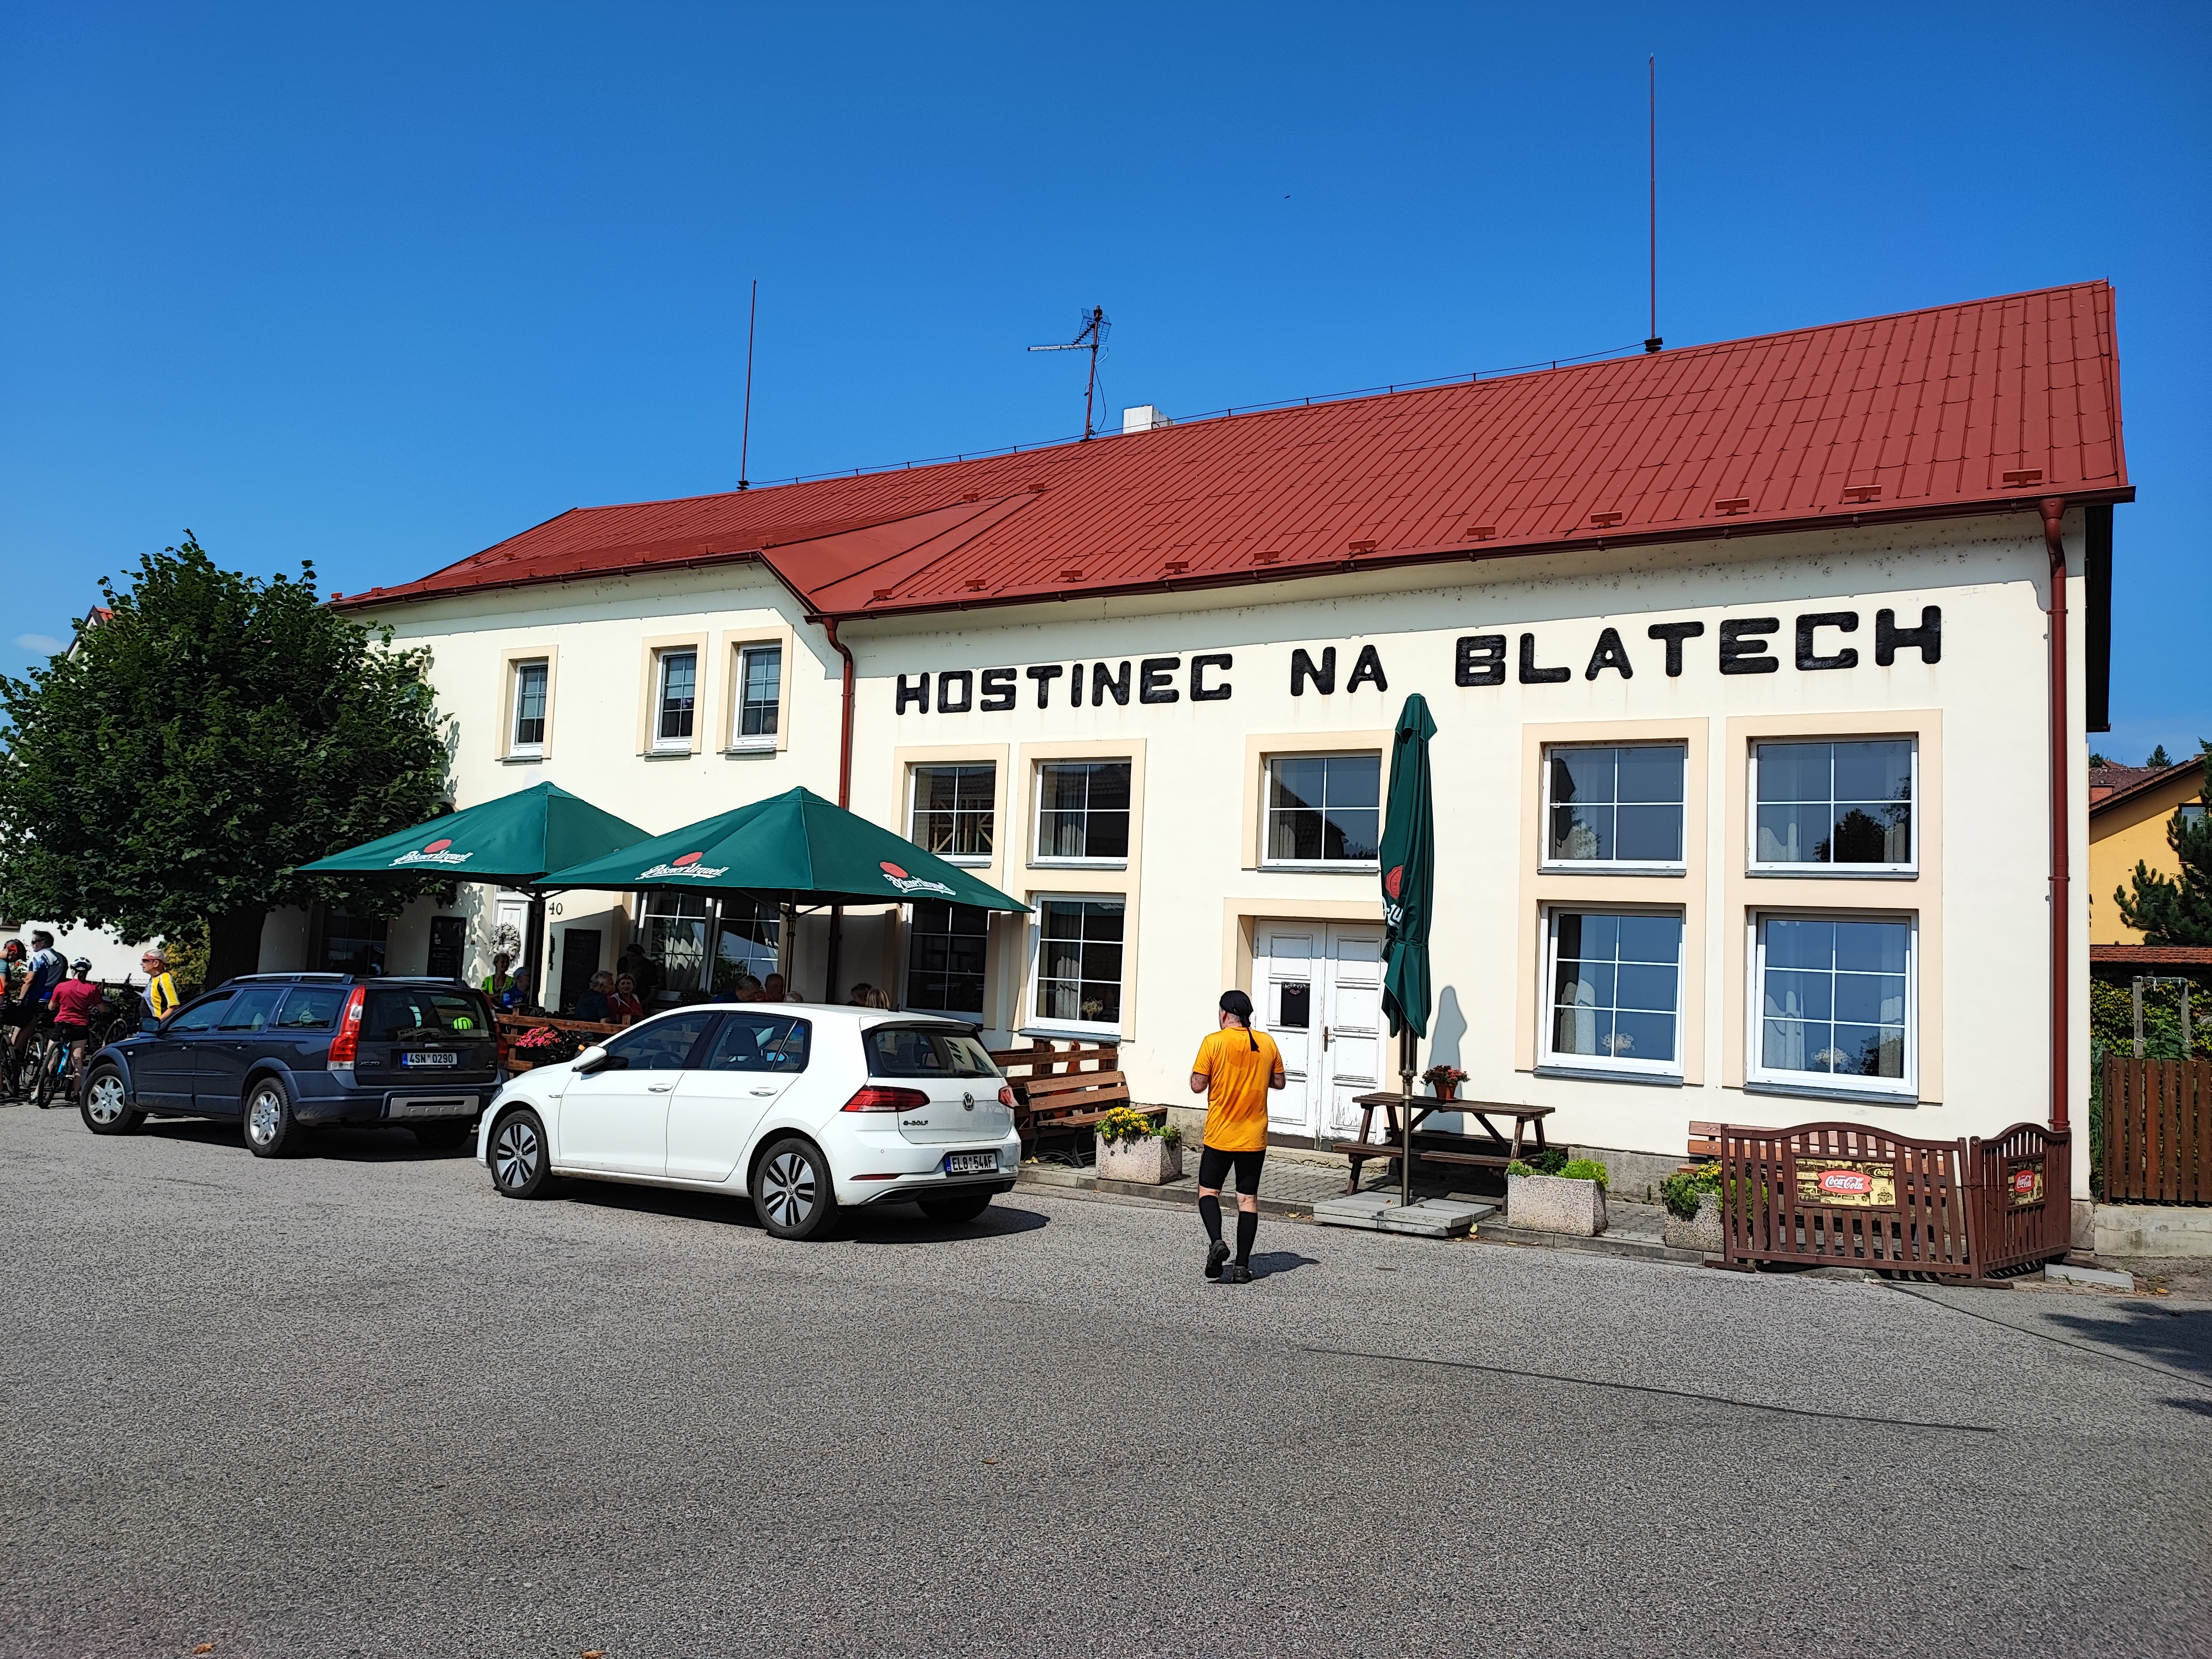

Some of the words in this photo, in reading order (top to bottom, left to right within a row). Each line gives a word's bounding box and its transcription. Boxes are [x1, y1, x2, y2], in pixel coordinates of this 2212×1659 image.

[896, 654, 1233, 716] HOSTINEC
[1291, 645, 1387, 696] NA
[1455, 606, 1942, 687] BLATECH
[548, 902, 563, 915] 40
[409, 1055, 426, 1063] 4SN
[432, 1055, 453, 1063] 0290
[952, 1156, 968, 1170] EL8
[973, 1155, 992, 1168] 54AF
[1825, 1175, 1864, 1190] Coca-Cola
